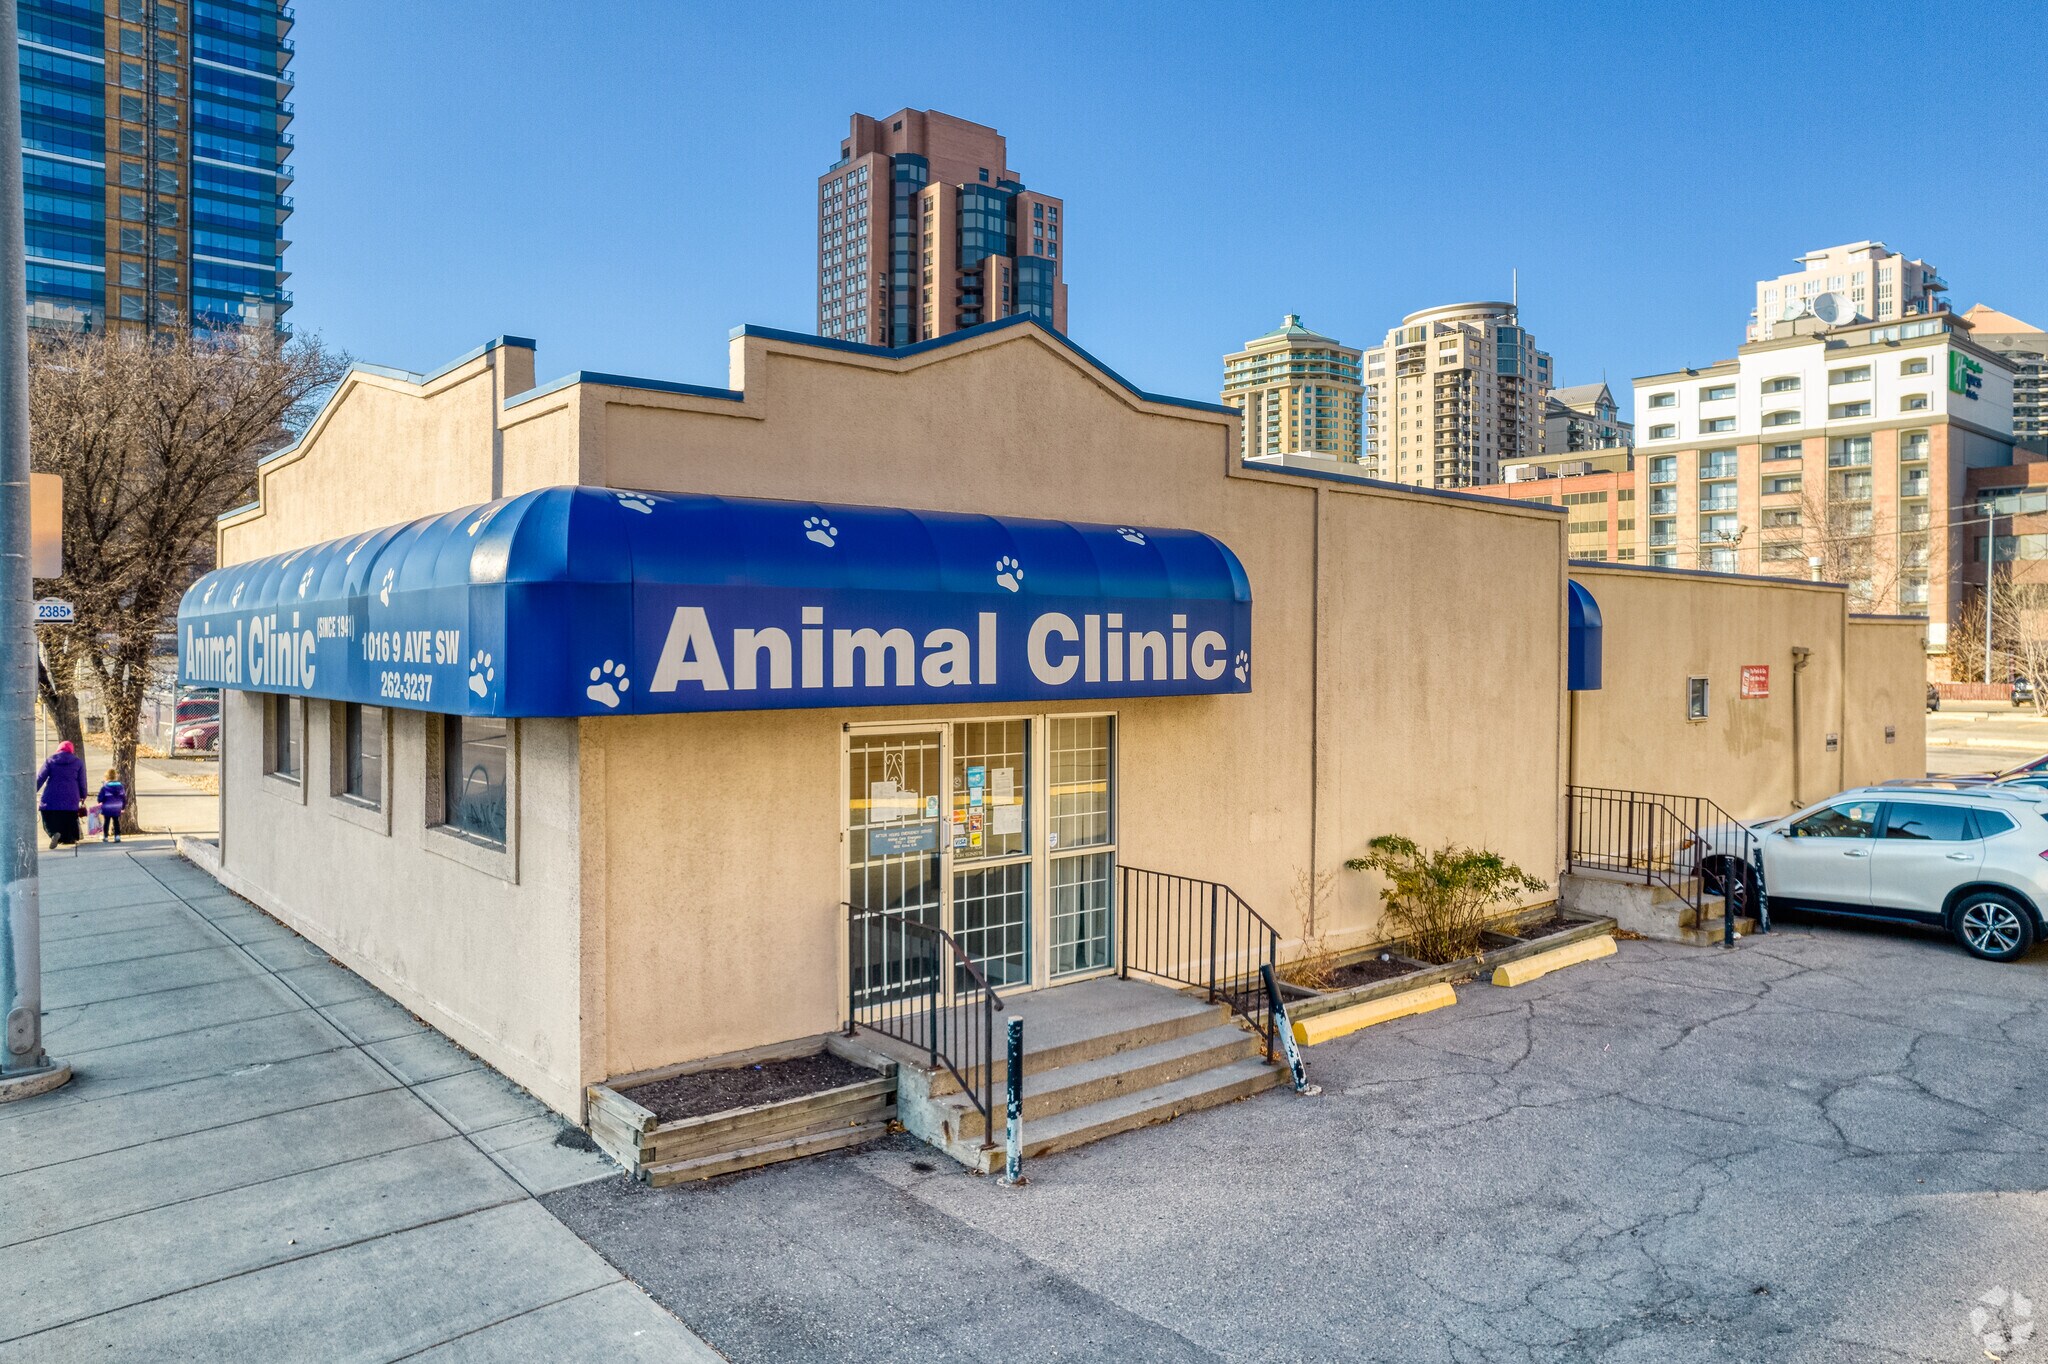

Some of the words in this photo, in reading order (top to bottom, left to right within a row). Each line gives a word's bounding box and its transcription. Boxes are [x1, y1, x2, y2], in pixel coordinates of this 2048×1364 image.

[39, 605, 66, 617] 2385
[316, 616, 336, 642] (SINCE
[336, 614, 355, 642] 1941)
[185, 619, 243, 684] Animal
[248, 611, 316, 690] Clinic
[362, 631, 390, 662] 1016
[392, 631, 401, 662] 9
[403, 631, 432, 663] AVE
[435, 630, 460, 664] SW
[649, 606, 997, 693] Animal
[1027, 612, 1228, 687] Clinic
[381, 671, 433, 702] 262-3237
